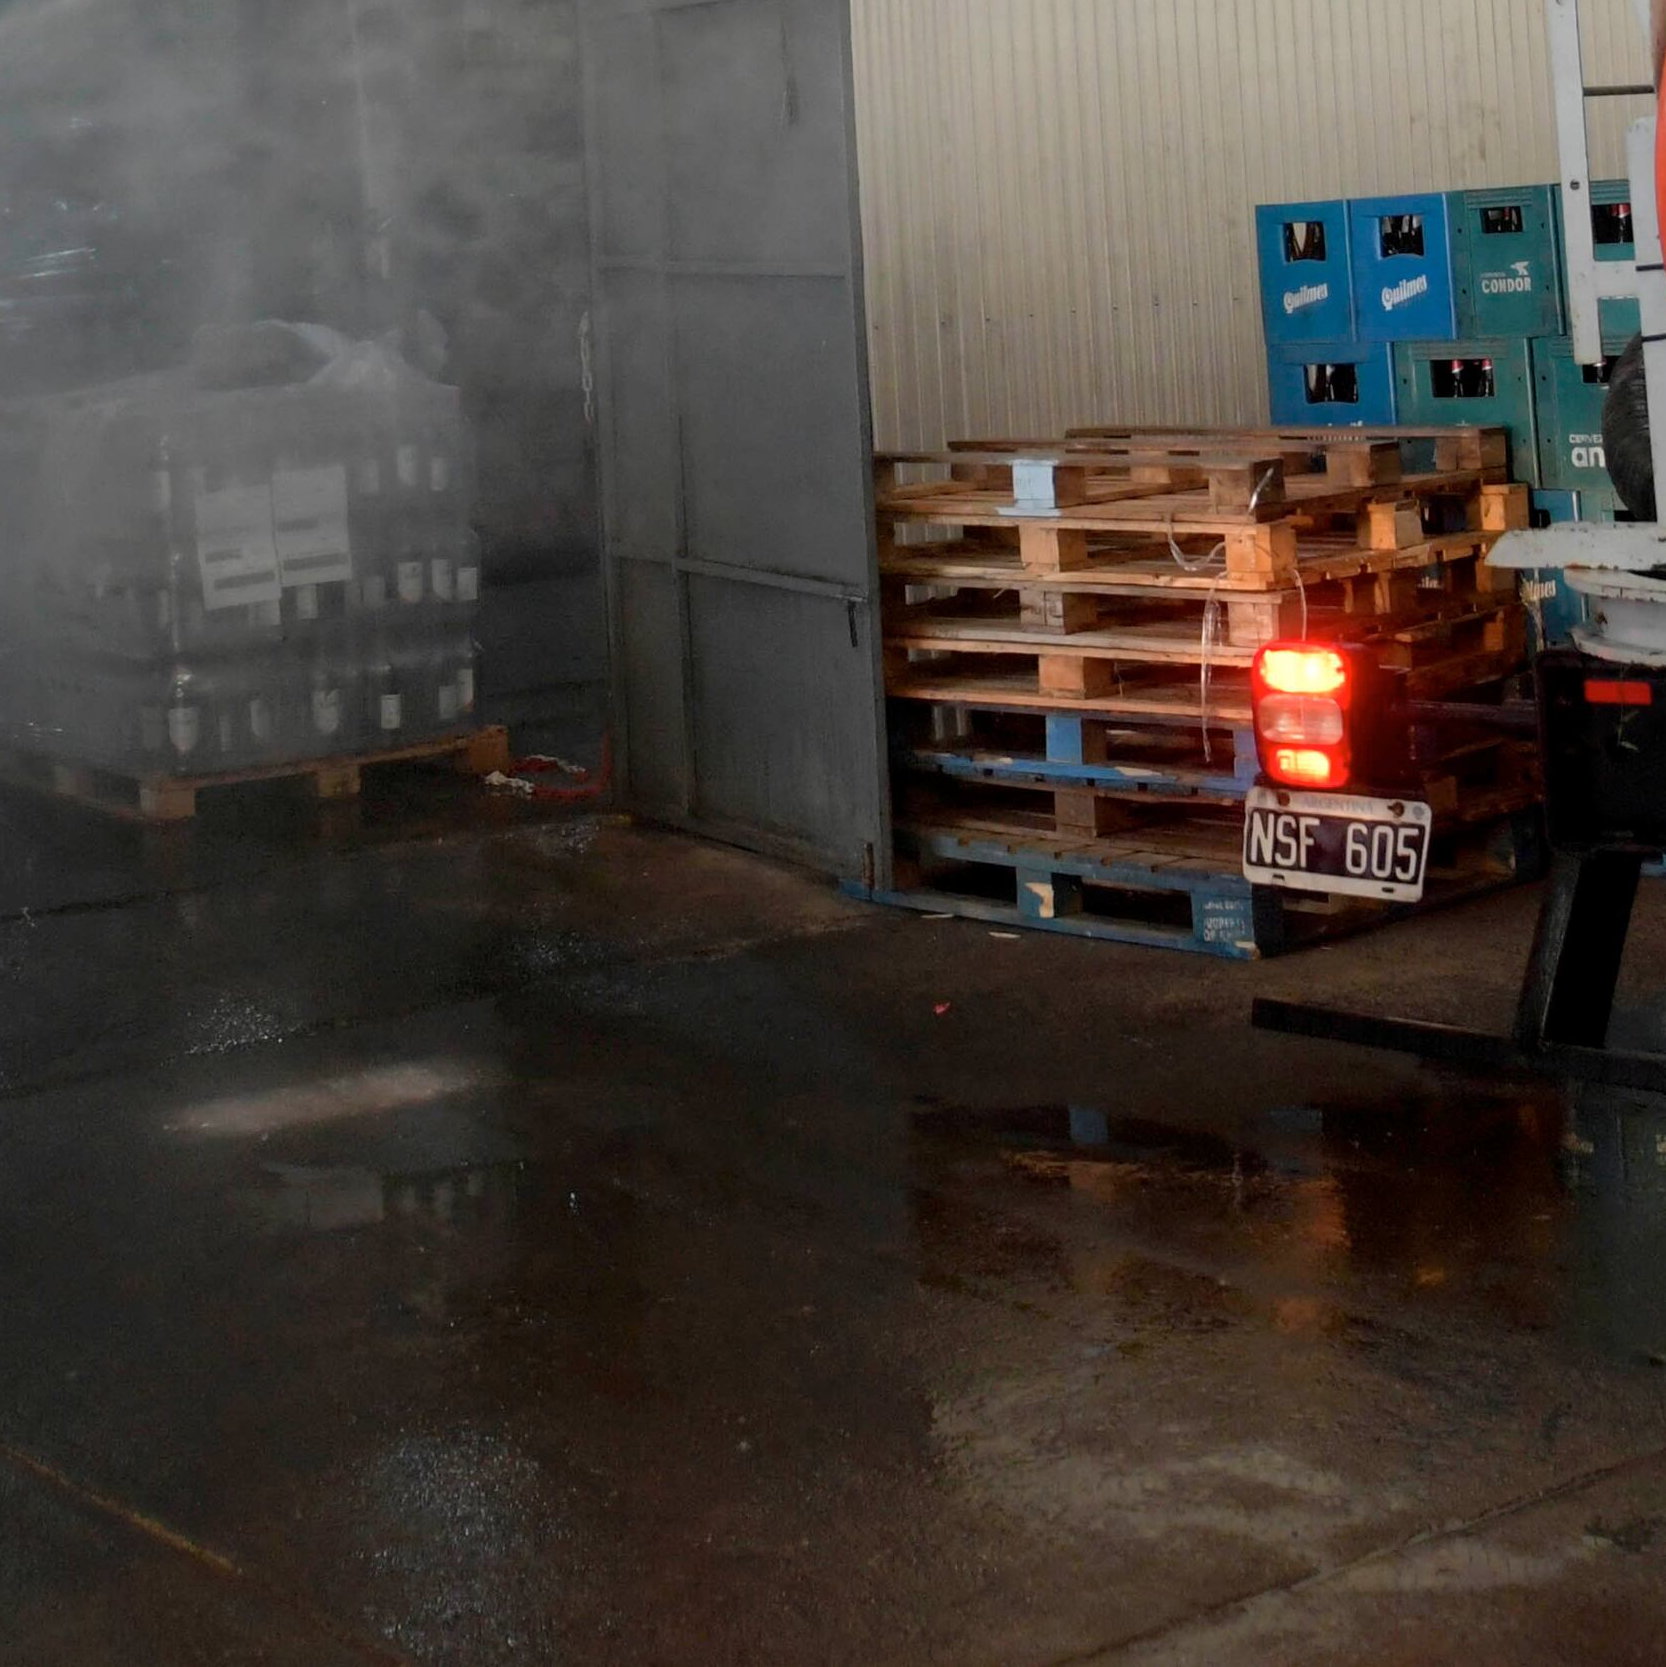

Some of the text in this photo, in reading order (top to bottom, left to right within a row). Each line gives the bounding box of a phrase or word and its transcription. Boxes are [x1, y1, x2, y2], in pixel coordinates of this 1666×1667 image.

[1283, 282, 1329, 314] Quilmes
[1381, 274, 1428, 311] Quilmes
[1481, 276, 1532, 294] CONDOR
[1250, 810, 1420, 881] NSF 605
